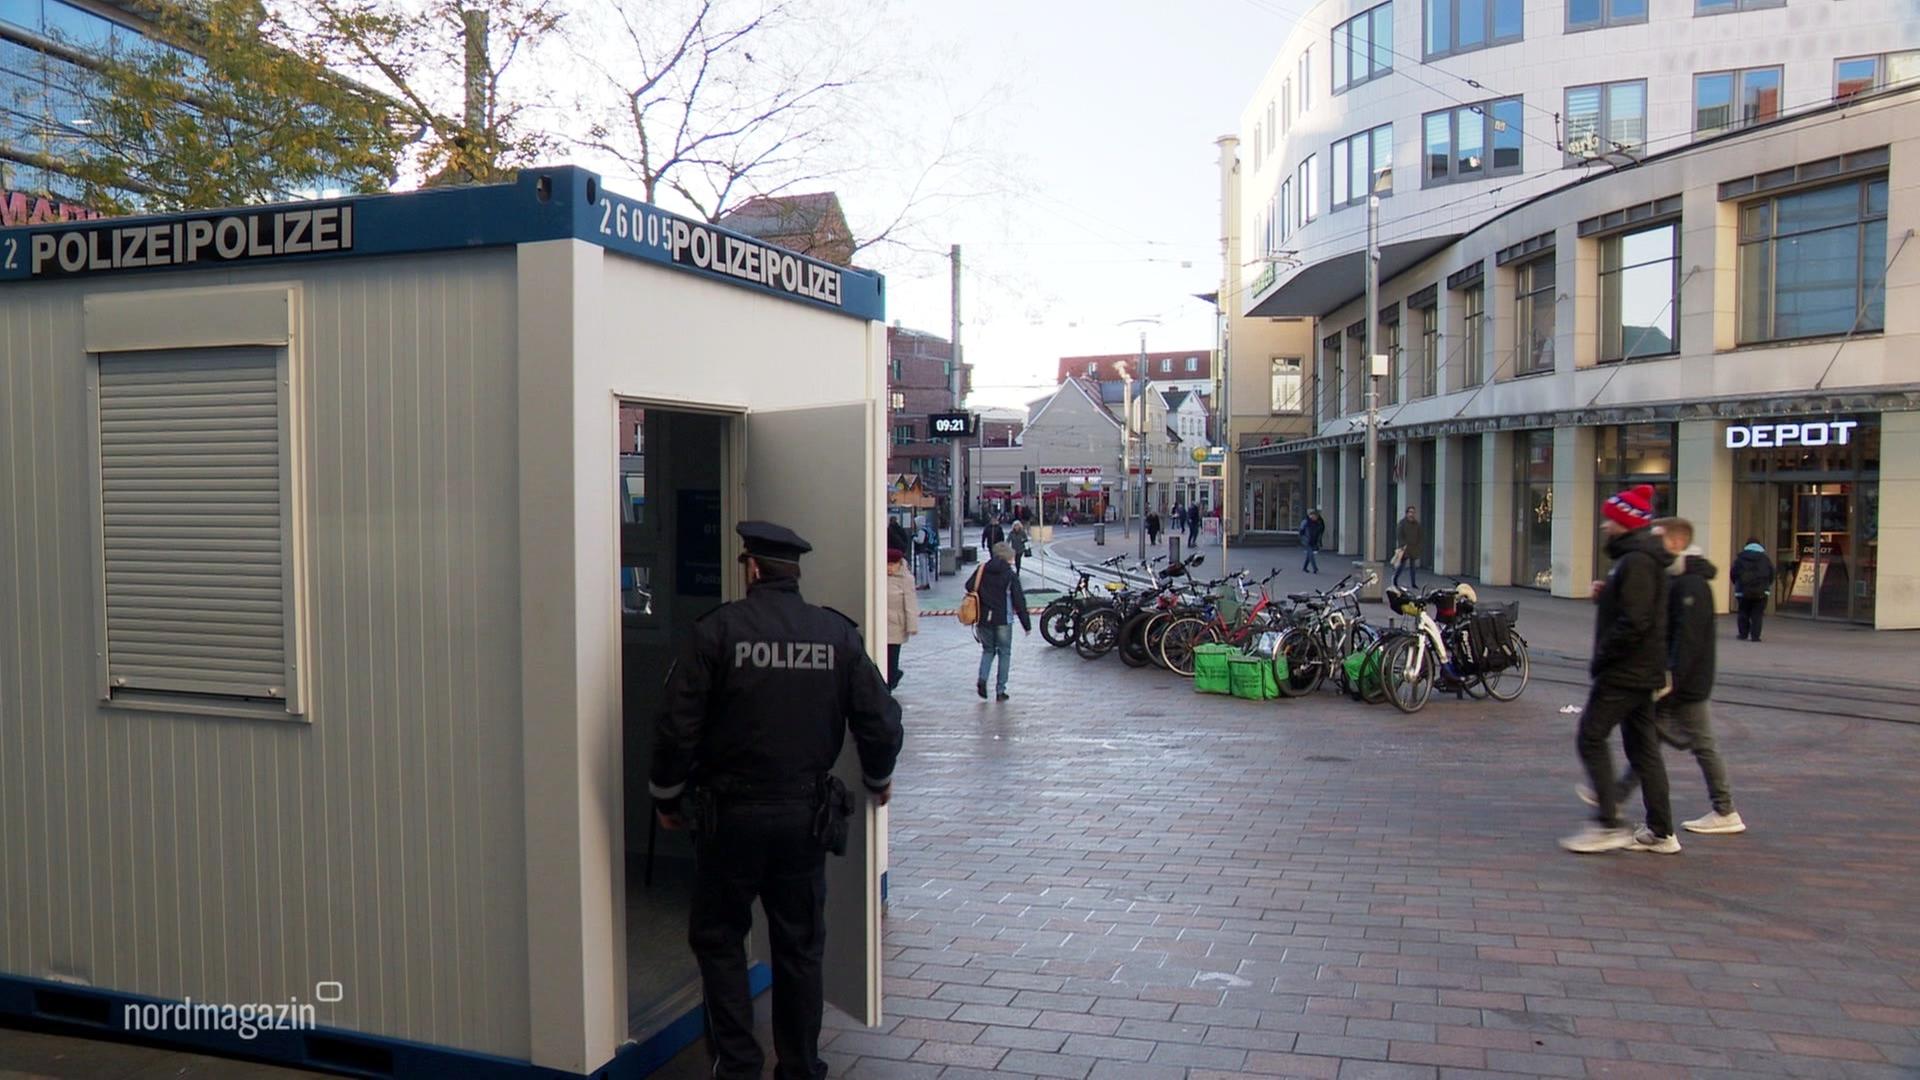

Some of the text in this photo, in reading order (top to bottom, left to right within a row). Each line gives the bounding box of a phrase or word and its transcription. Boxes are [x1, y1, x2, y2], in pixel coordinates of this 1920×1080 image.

[31, 206, 352, 274] POLIZEI POLIZEI
[600, 198, 672, 250] 26005
[673, 219, 841, 305] POLIZEI POLIZEI
[935, 419, 964, 431] 09:21
[1726, 422, 1857, 448] DEPOT
[735, 641, 835, 670] POLIZEI
